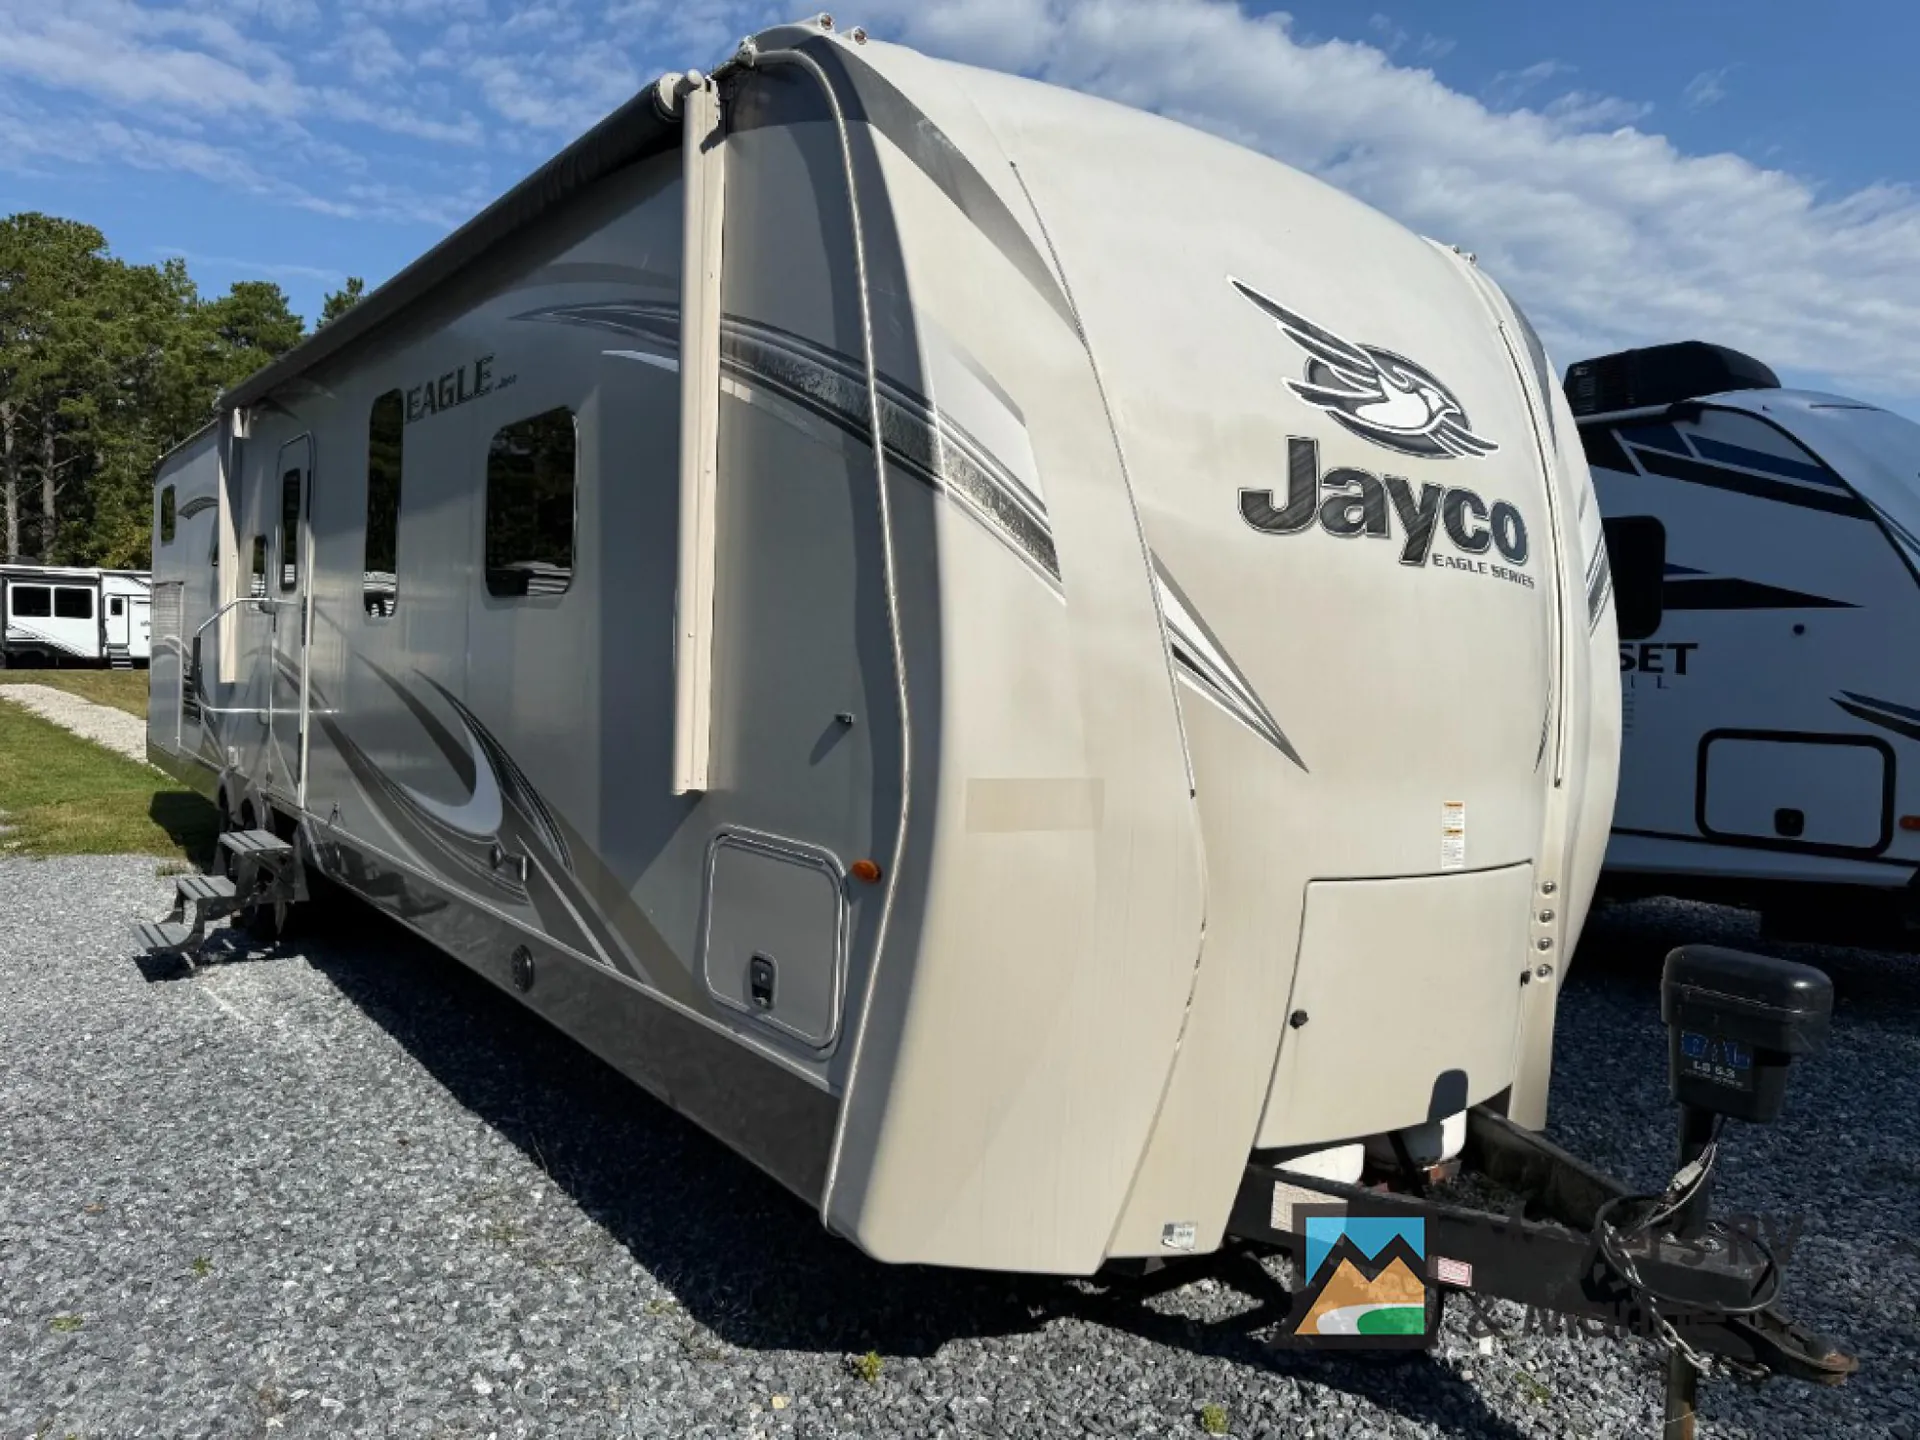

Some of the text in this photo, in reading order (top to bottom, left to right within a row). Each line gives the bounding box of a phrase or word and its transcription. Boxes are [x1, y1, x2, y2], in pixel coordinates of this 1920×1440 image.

[405, 352, 496, 424] EAGLE
[1237, 434, 1529, 567] Jayco
[1432, 552, 1535, 589] EAGLE SERIES
